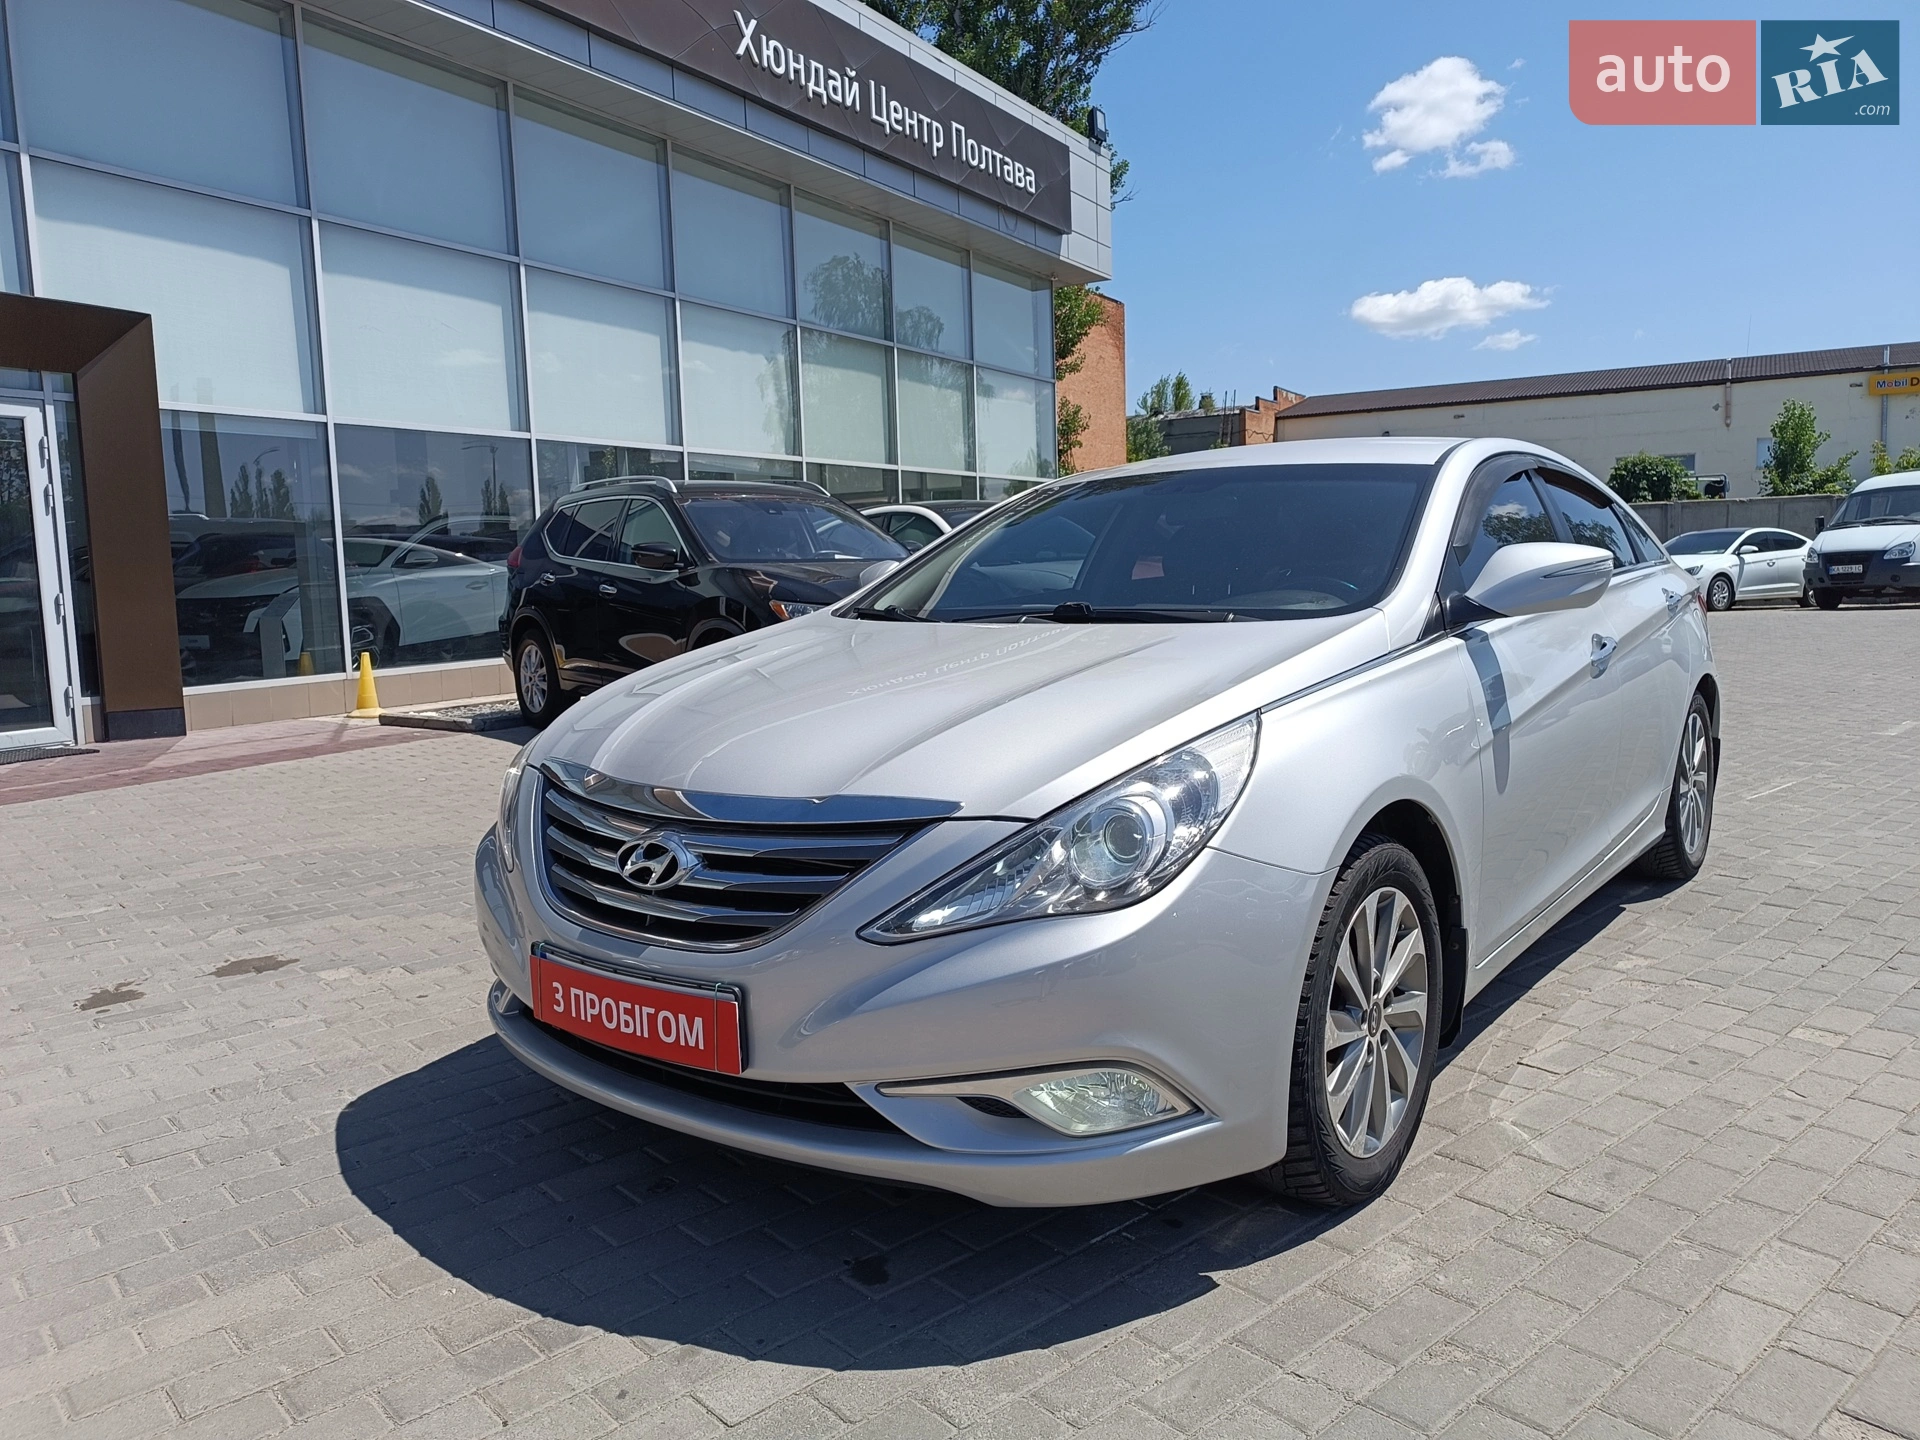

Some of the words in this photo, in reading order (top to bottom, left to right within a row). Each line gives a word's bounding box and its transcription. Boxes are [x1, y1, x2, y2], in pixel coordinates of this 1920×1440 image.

[733, 9, 860, 113] Хюндай
[868, 79, 944, 157] Центр
[950, 120, 1036, 195] Полтава
[1876, 379, 1907, 388] Mobil
[552, 981, 564, 1013] З
[570, 987, 704, 1050] ПРОБІГОМ
